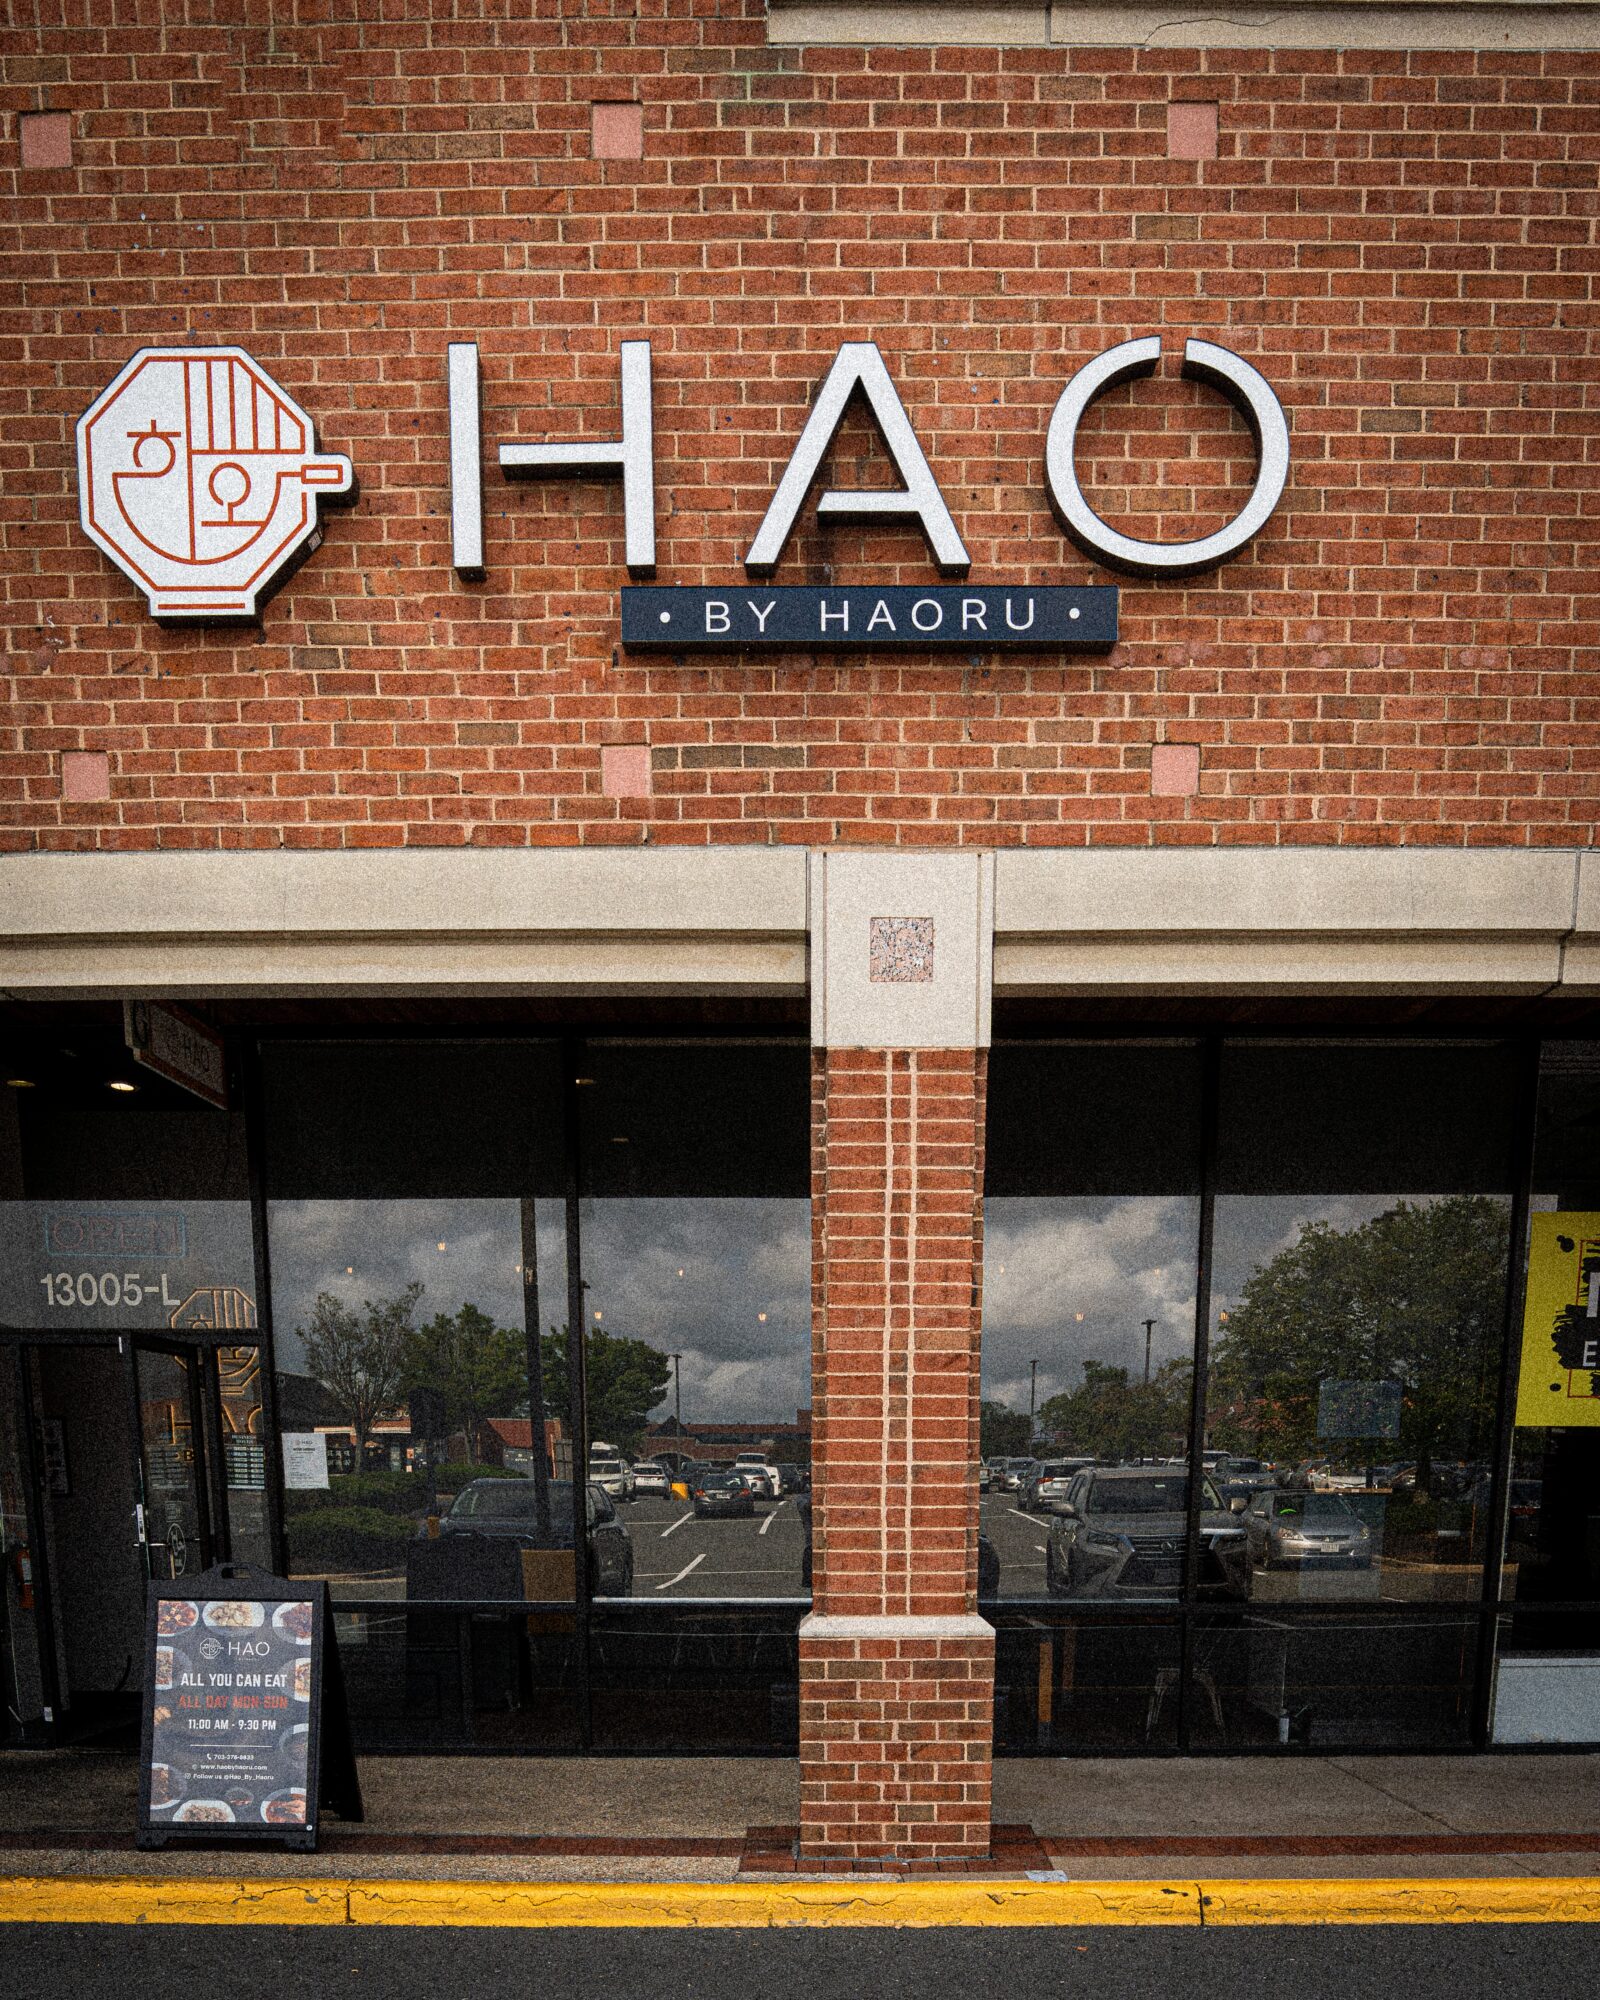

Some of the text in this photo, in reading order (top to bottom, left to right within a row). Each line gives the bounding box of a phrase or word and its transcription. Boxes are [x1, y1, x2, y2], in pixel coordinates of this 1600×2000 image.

[448, 335, 1290, 576] HAO
[705, 597, 1036, 633] BY HAORU
[53, 1216, 178, 1251] OPEN
[40, 1272, 181, 1306] 13005-L
[228, 1641, 271, 1656] HAO
[180, 1673, 288, 1688] ALL YOU CAN EAT
[178, 1695, 288, 1709] ALL DAY MON-SUN
[188, 1719, 211, 1730] 11:00
[213, 1719, 229, 1730] AM
[238, 1719, 259, 1730] 9:30
[261, 1720, 277, 1730] PM
